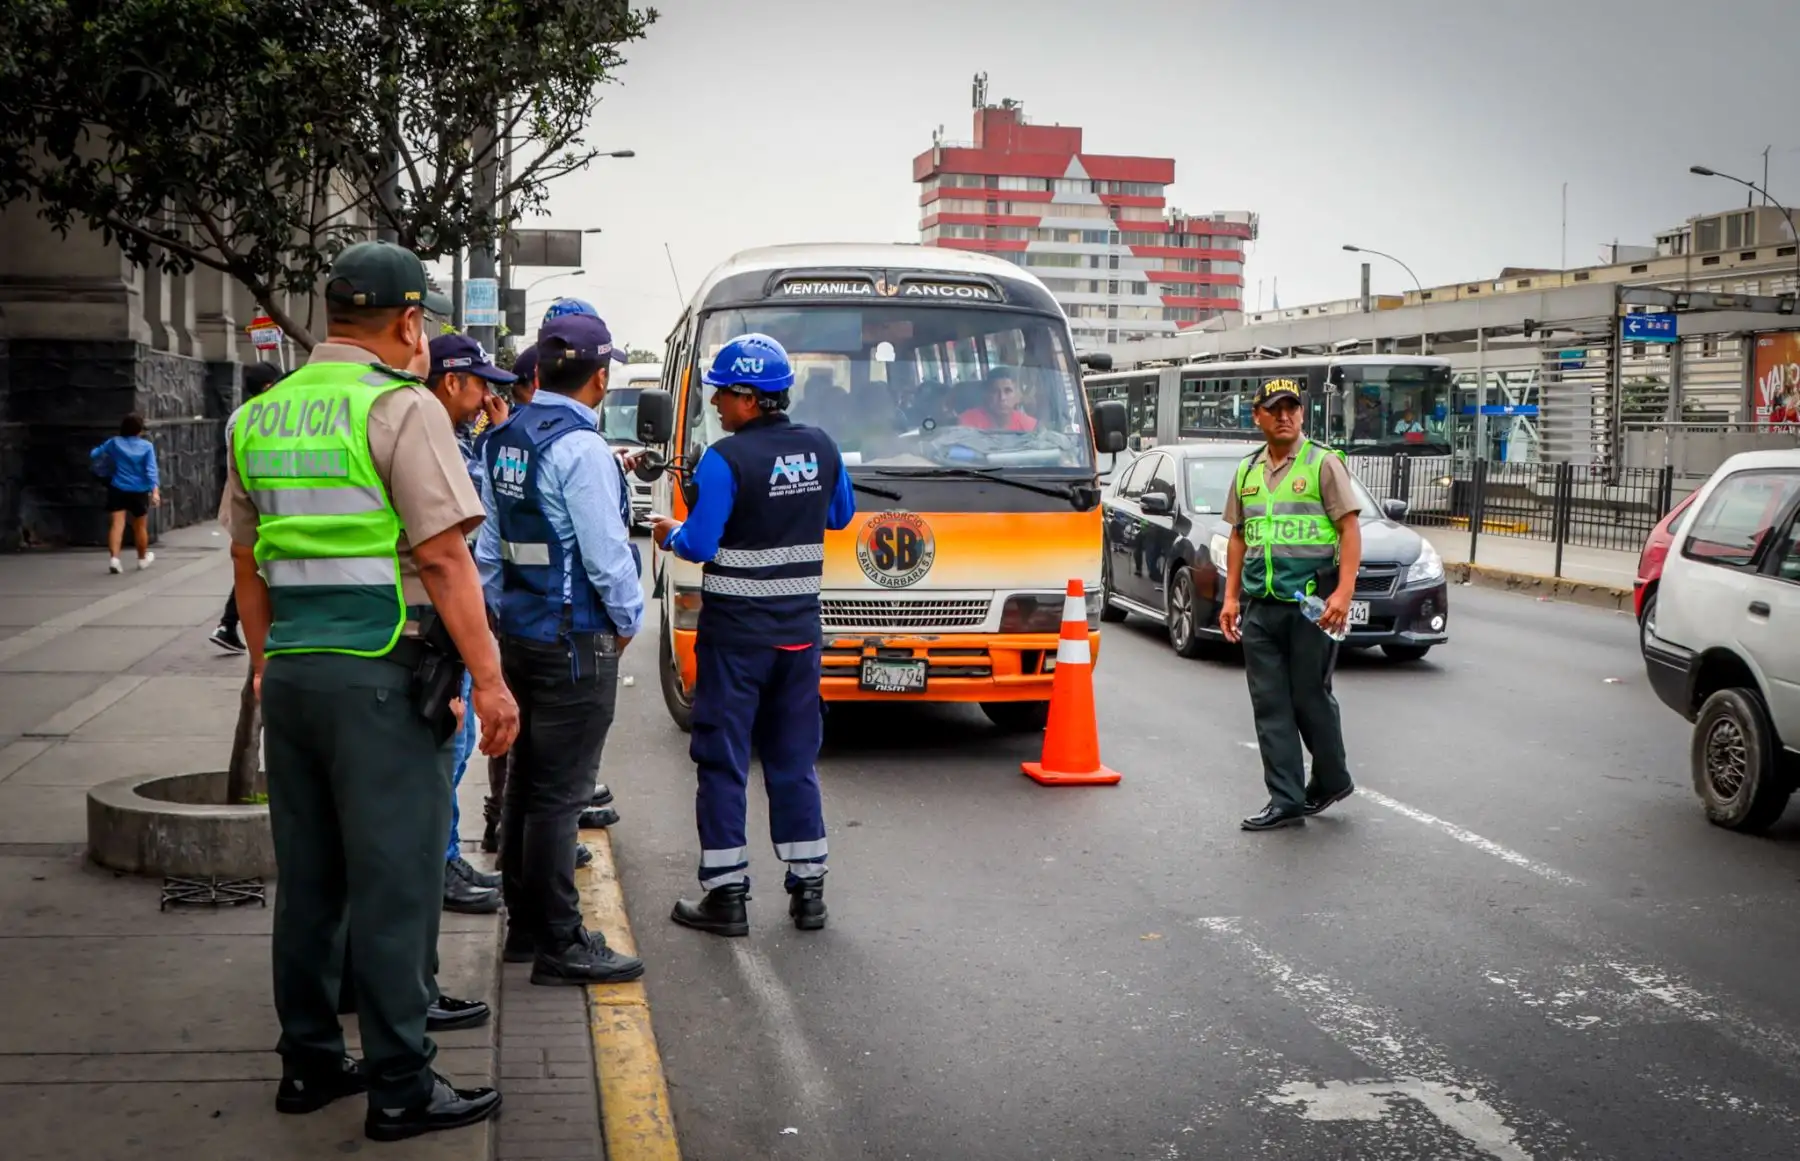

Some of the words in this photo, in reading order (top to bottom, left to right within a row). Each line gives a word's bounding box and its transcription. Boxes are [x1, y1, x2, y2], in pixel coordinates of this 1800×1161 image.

[783, 283, 871, 295] VENTANILLA
[905, 284, 989, 299] ANCON
[731, 356, 764, 373] ATU
[1265, 379, 1299, 397] POLICIA
[245, 397, 350, 438] POLICIA
[493, 446, 528, 484] ATU
[769, 452, 819, 485] ATU
[868, 511, 923, 528] CONSORCIO
[875, 526, 918, 571] SB
[859, 551, 879, 580] SANTA
[879, 568, 925, 586] BARBARA
